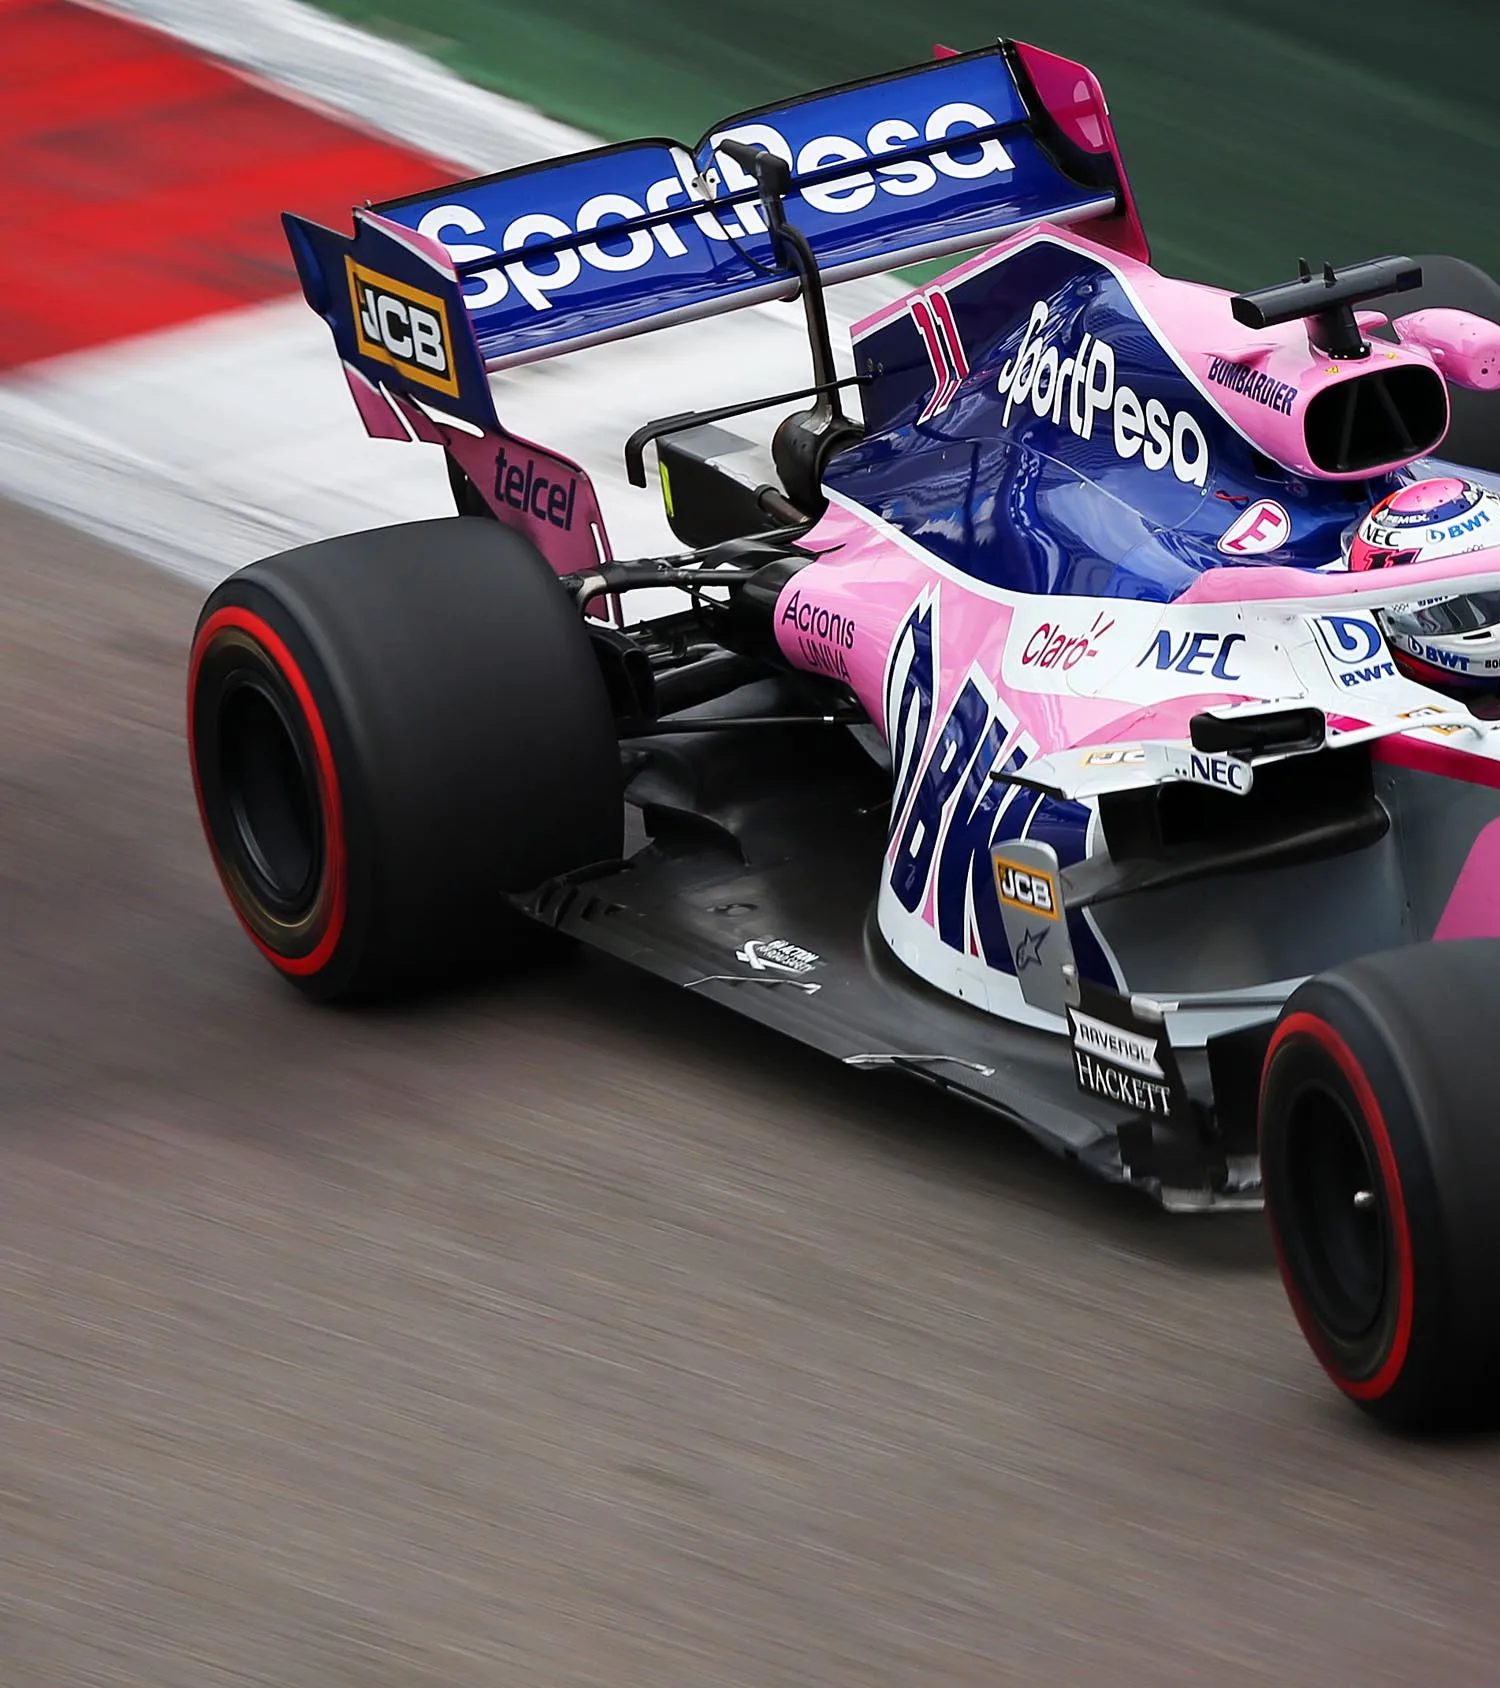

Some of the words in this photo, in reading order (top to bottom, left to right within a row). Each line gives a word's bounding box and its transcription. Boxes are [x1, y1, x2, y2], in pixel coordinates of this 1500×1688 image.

[413, 102, 1014, 312] SportPesa
[361, 288, 447, 374] JCB
[908, 284, 970, 424] 11
[998, 300, 1209, 488] SportPesa
[1208, 356, 1298, 416] BOMBARDIER
[494, 449, 577, 532] telcel
[1361, 524, 1401, 548] NEC
[1448, 510, 1491, 539] BWT
[781, 589, 856, 650] Acronis
[1135, 629, 1246, 681] NEC
[1339, 662, 1395, 687] BWT
[1425, 645, 1470, 672] BWT
[1088, 750, 1146, 765] JC
[1190, 754, 1242, 790] NEC
[1002, 869, 1053, 911] JCB
[1075, 1050, 1170, 1117] HACKETT
